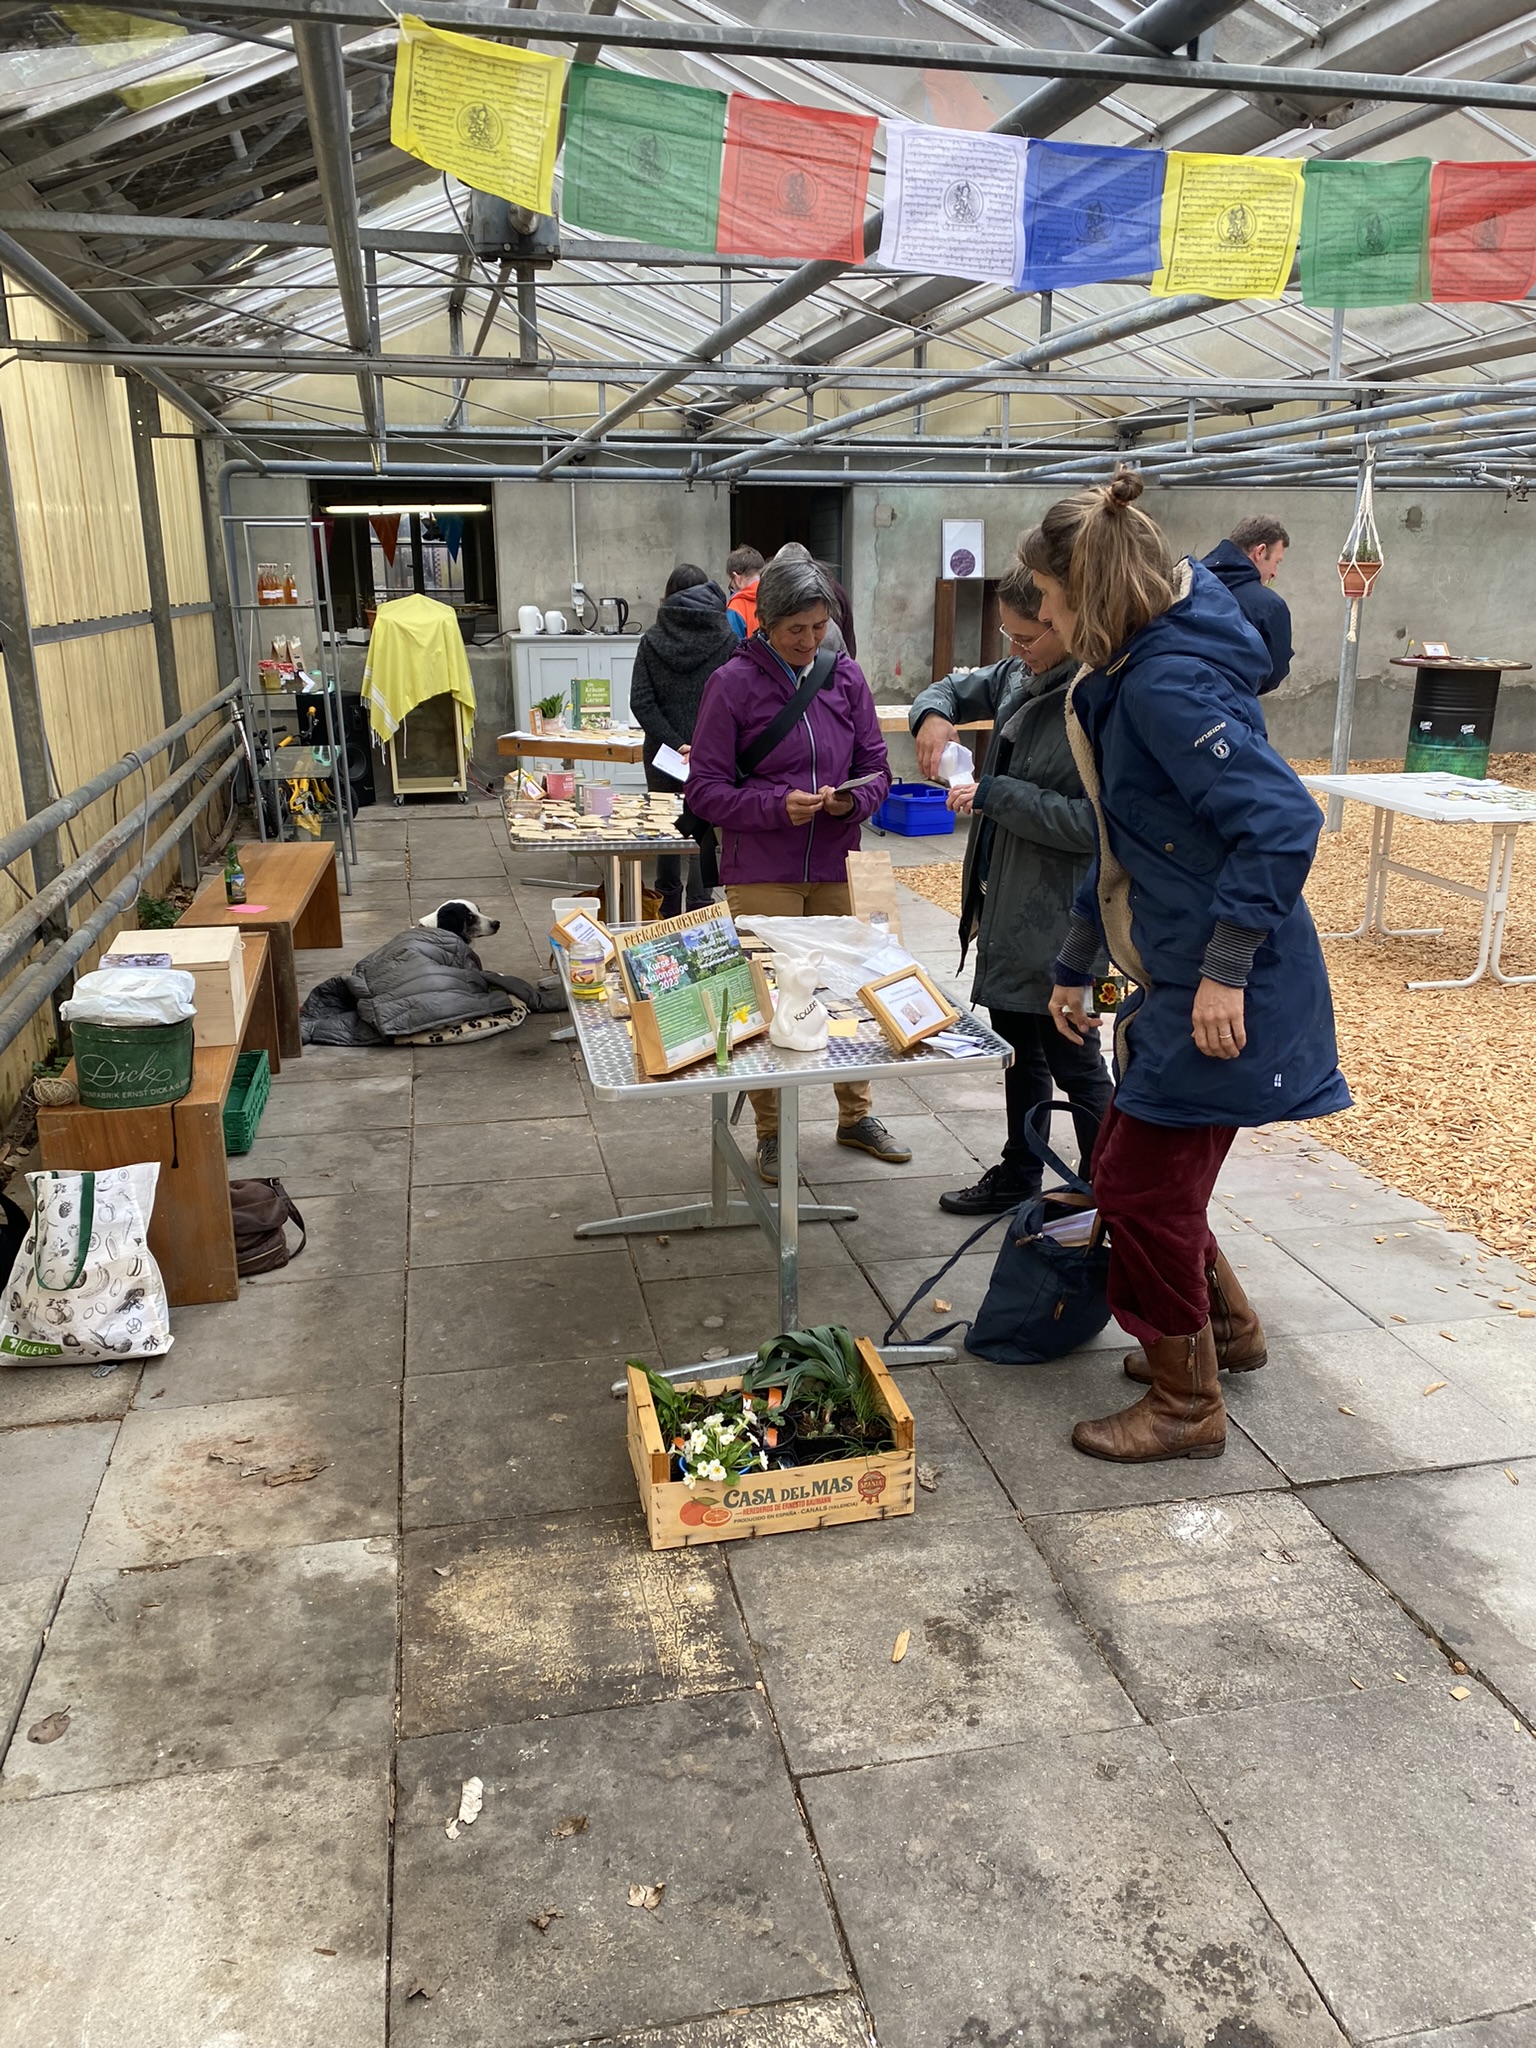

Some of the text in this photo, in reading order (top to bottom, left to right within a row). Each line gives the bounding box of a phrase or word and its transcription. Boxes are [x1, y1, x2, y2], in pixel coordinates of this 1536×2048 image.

[646, 955, 678, 972] Kurse &
[642, 963, 689, 985] Aktionstage
[658, 976, 680, 991] 2023
[80, 1051, 173, 1090] Dick
[122, 1089, 148, 1099] ERNST
[724, 1487, 776, 1509] CASA
[780, 1486, 812, 1502] DEL
[812, 1476, 853, 1497] MAS
[742, 1504, 774, 1516] HEREDEROS
[782, 1500, 805, 1511] ERNESTO
[800, 1505, 828, 1515] CANALS
